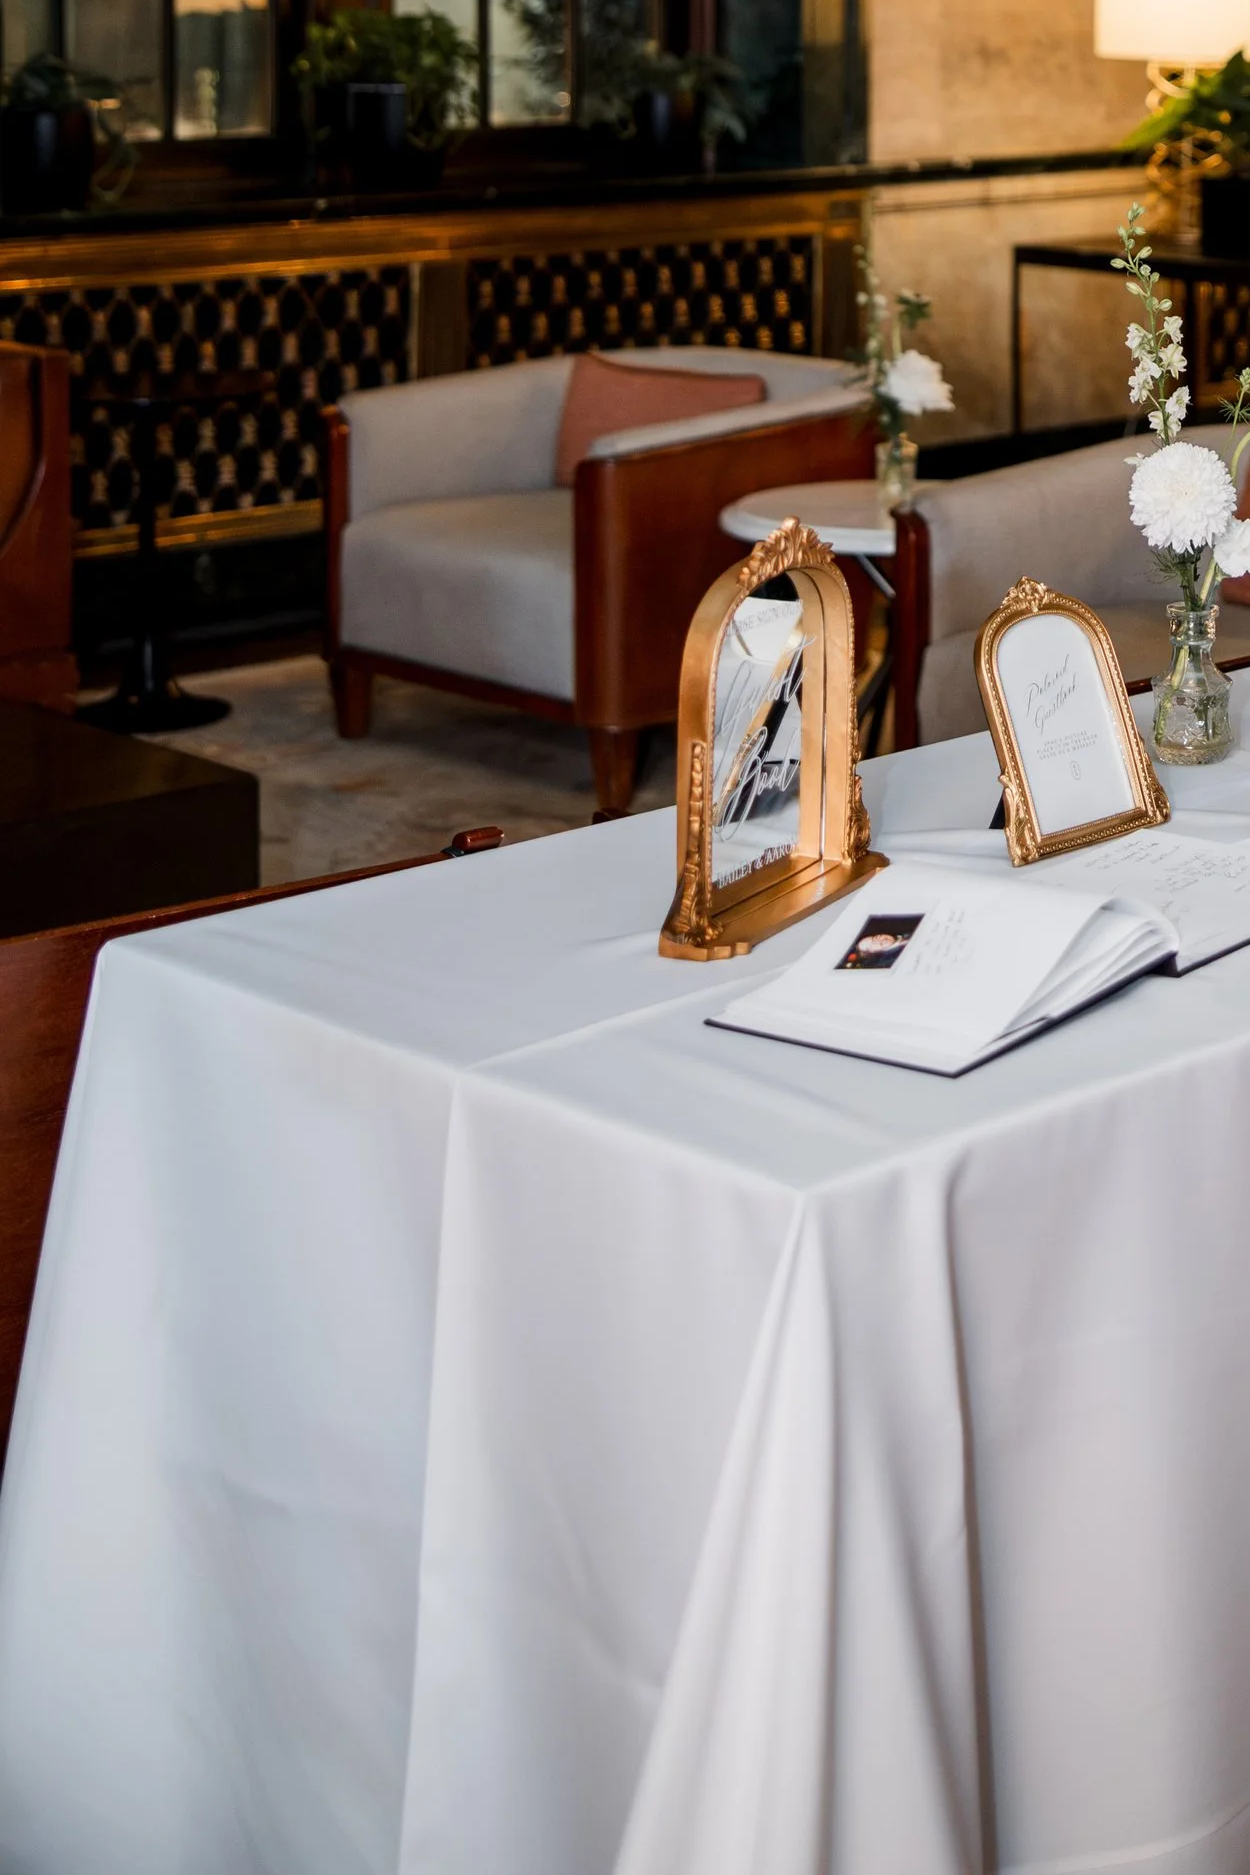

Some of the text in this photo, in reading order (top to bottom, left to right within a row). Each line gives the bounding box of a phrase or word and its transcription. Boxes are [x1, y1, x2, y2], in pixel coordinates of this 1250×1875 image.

[714, 634, 817, 782] Guest
[1034, 673, 1078, 736] Guestbook
[714, 726, 801, 843] Book
[717, 858, 754, 890] BAILEY
[754, 855, 765, 871] &
